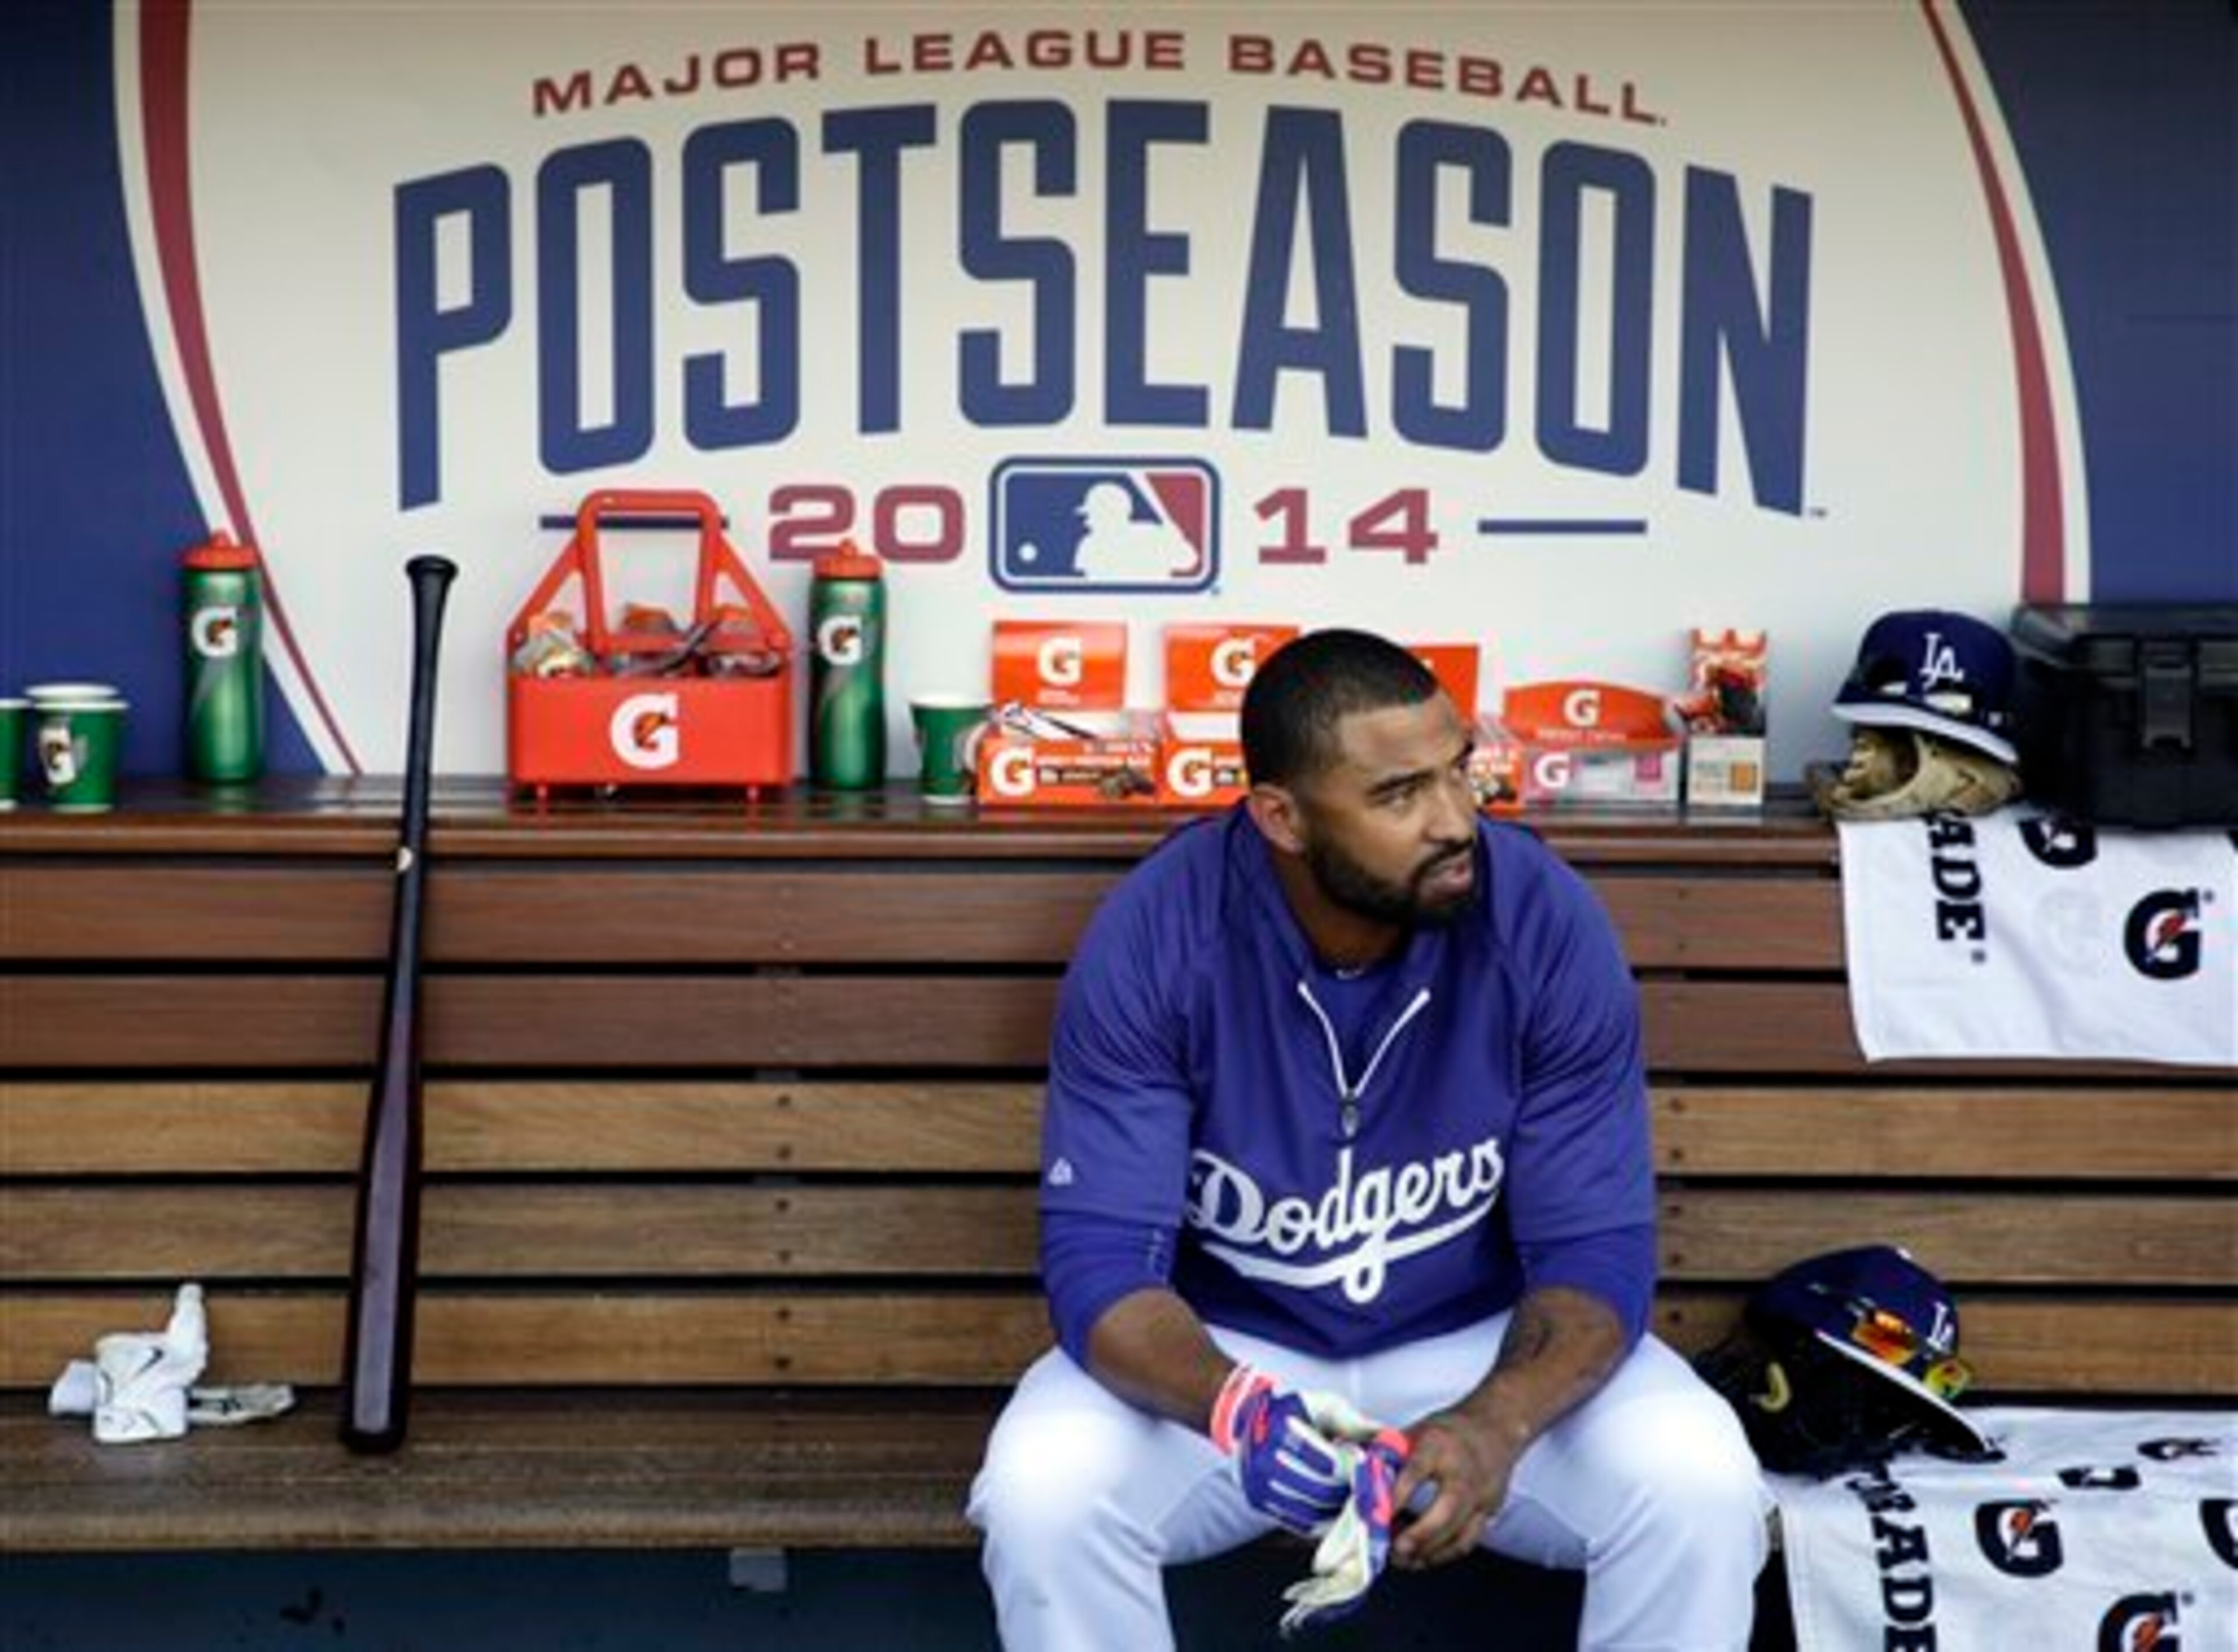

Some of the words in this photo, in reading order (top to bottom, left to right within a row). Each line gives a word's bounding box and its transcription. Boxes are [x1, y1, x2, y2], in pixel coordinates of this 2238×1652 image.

[533, 43, 821, 118] MAJOR
[864, 28, 1185, 75] LEAGUE
[1229, 34, 1658, 125] BASEBALL
[394, 97, 1814, 517] POSTSEASON
[769, 484, 966, 563] 20
[1254, 488, 1438, 565] 14
[192, 606, 238, 657] G
[819, 615, 862, 666] G
[1038, 636, 1082, 685] G
[1211, 636, 1257, 688] G
[1920, 632, 1965, 688] LA
[610, 693, 679, 769] G
[1564, 689, 1600, 727] G
[991, 746, 1035, 797] G
[1167, 747, 1213, 798] G
[1534, 753, 1571, 789] G
[2124, 887, 2202, 981] G
[1189, 1137, 1505, 1304] Dodgers
[1976, 1498, 2064, 1579] G
